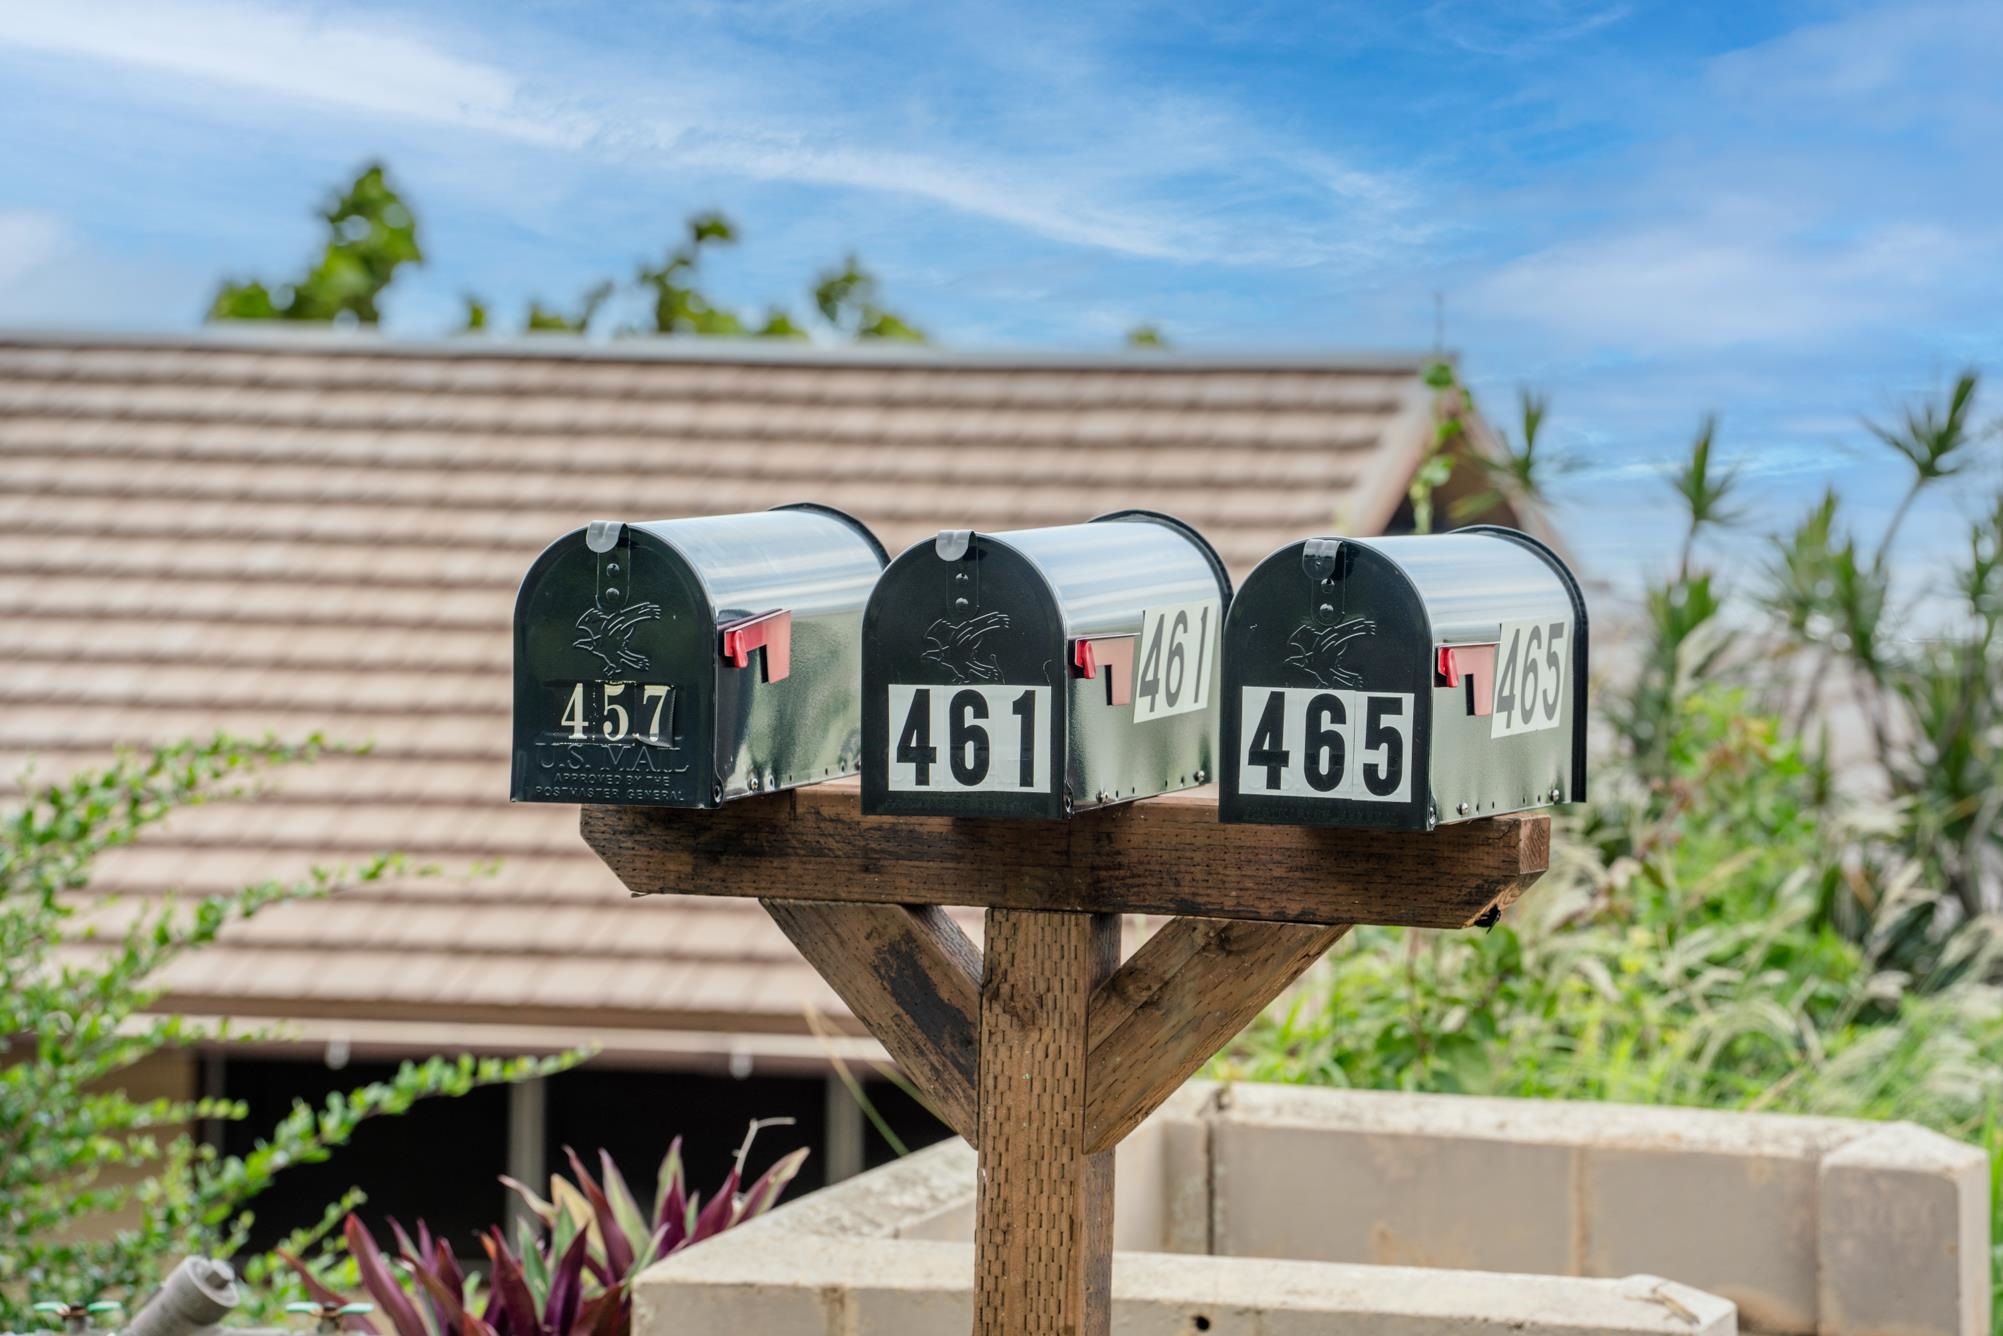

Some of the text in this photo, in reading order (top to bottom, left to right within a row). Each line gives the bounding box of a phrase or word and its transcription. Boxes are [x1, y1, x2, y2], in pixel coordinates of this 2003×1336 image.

[1139, 606, 1209, 712] 461
[1496, 621, 1565, 729] 465
[561, 683, 671, 742] 457
[896, 688, 1036, 787] 461
[1248, 691, 1404, 797] 465
[535, 786, 685, 801] POSTMASTER GENERAL
[554, 773, 671, 787] APPROVED BY THE
